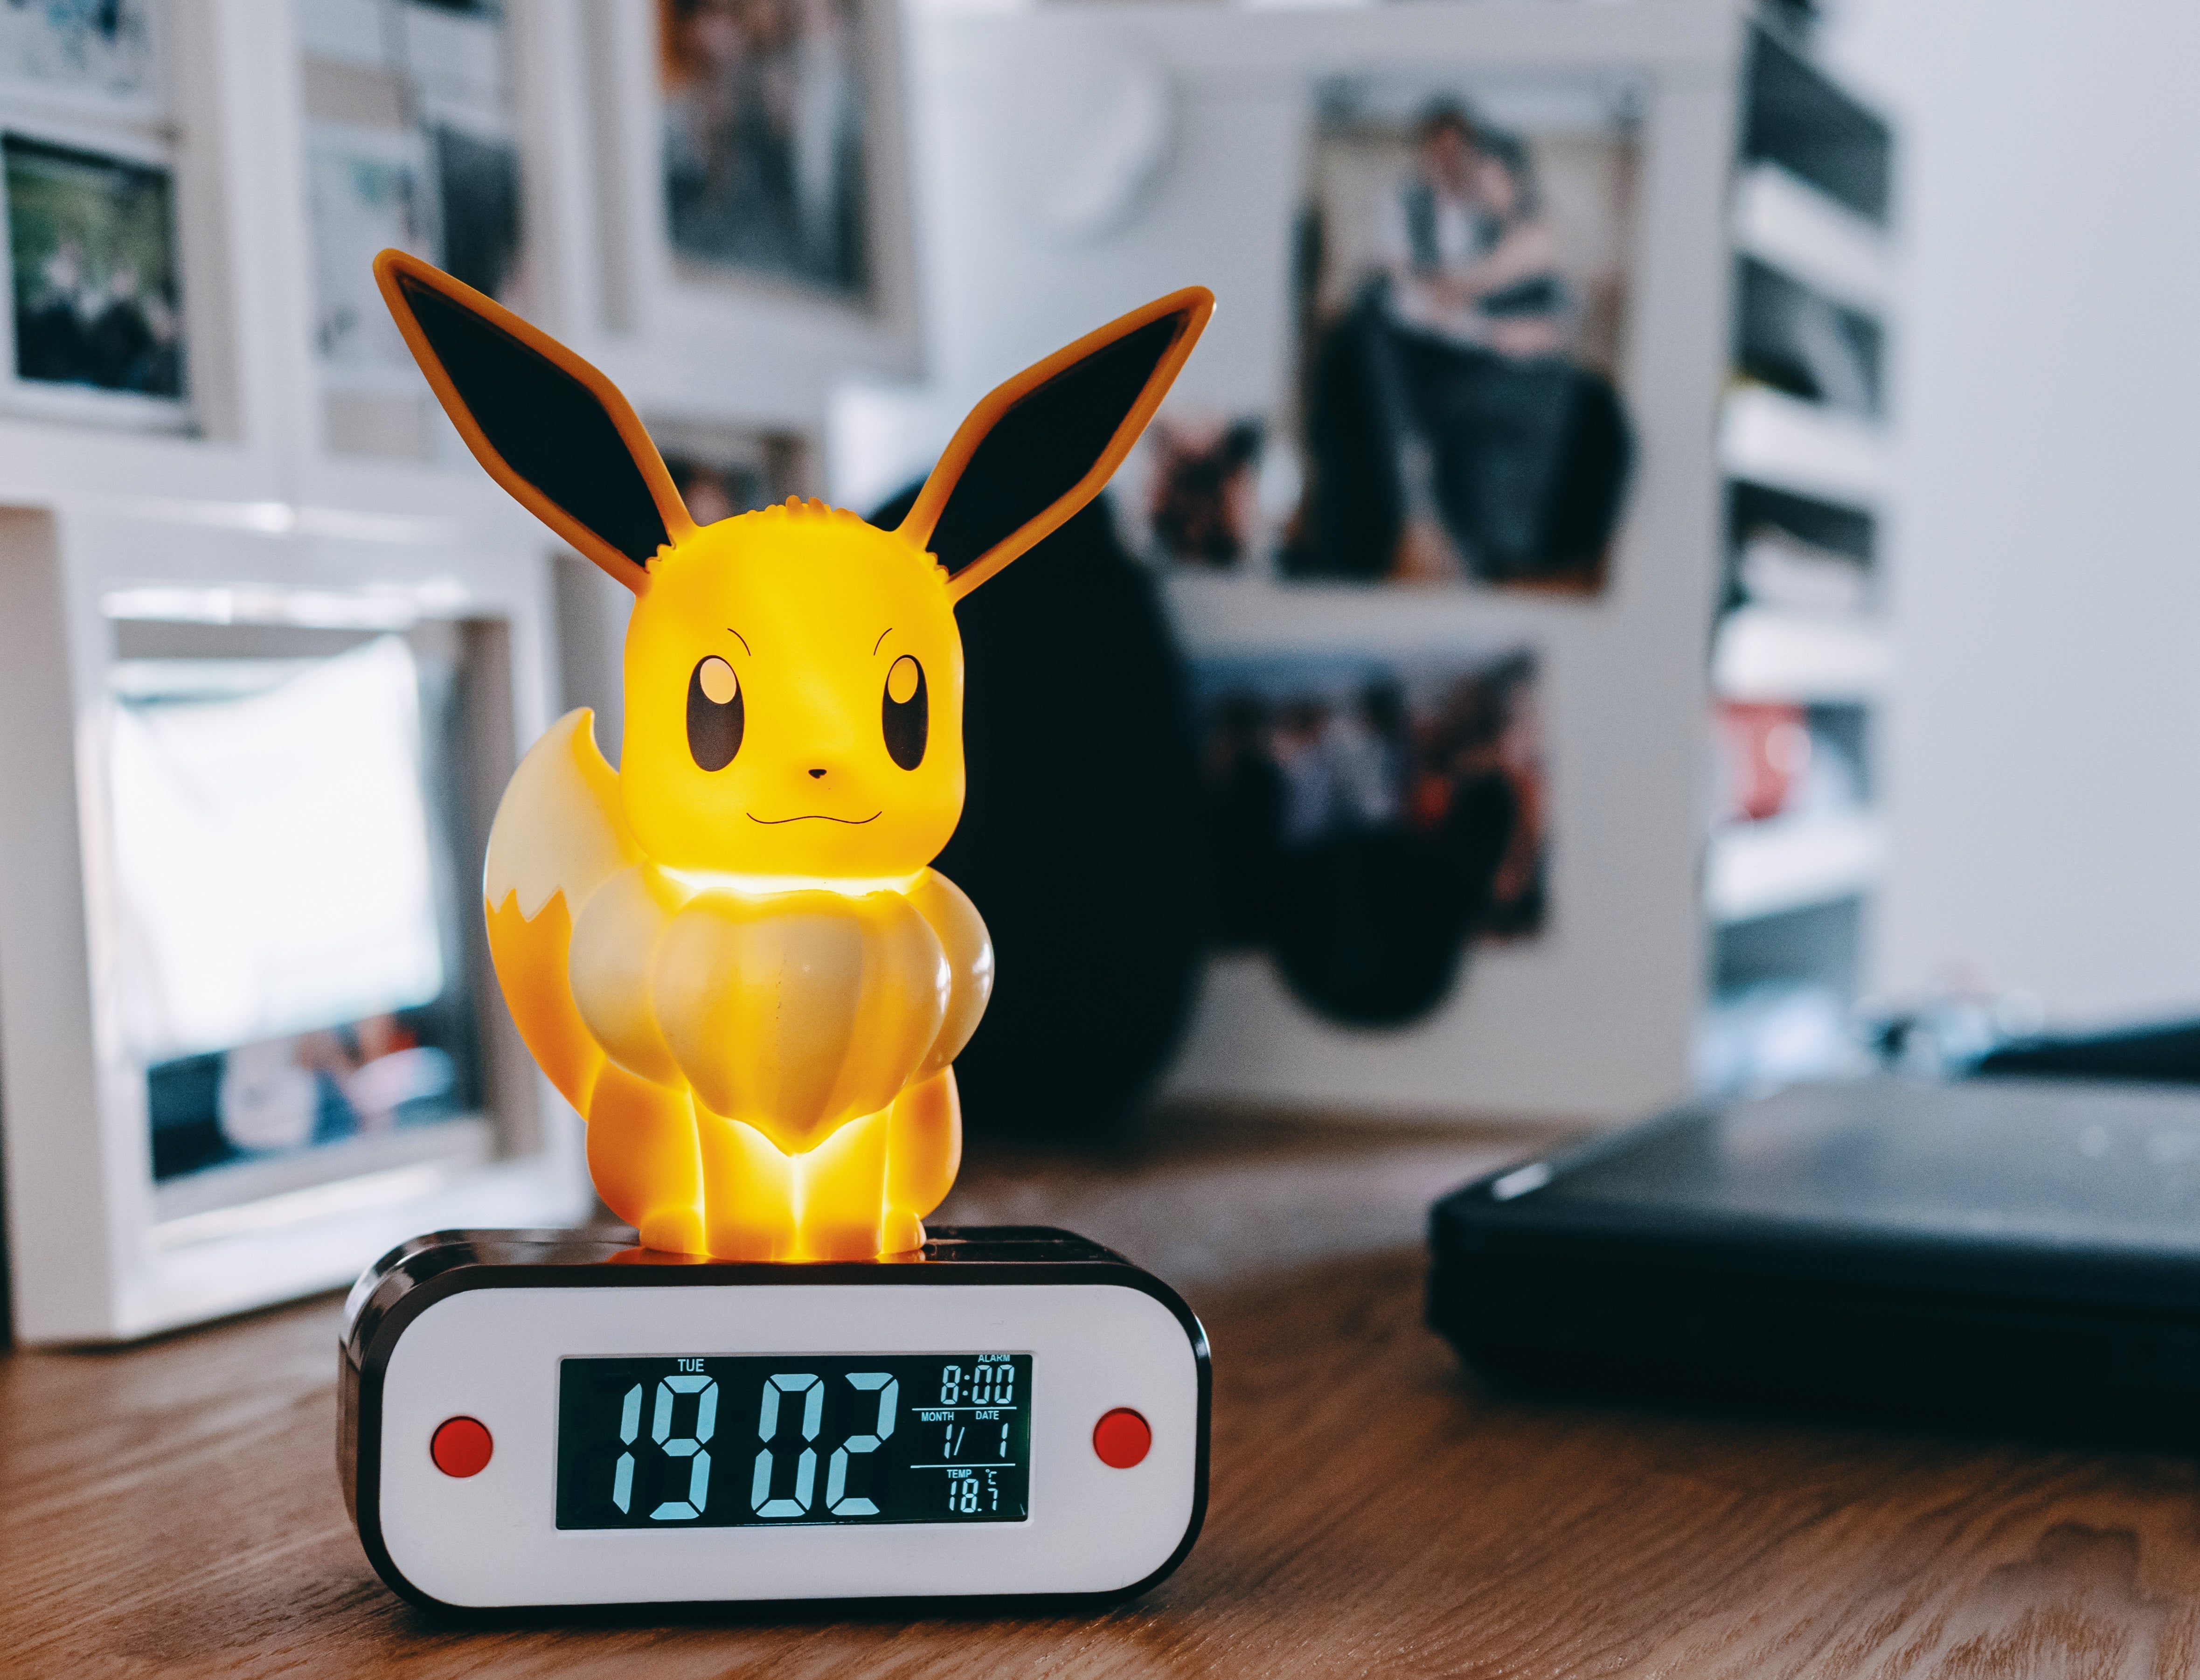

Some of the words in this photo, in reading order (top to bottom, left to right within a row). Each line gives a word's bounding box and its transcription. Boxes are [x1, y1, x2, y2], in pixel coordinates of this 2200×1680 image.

[678, 1359, 704, 1372] TUE
[941, 1365, 1014, 1404] 8:00
[922, 1412, 954, 1421] MONTH
[976, 1410, 999, 1420] DATE
[613, 1375, 718, 1520] 19
[751, 1373, 898, 1517] 02
[947, 1469, 972, 1478] TEMP
